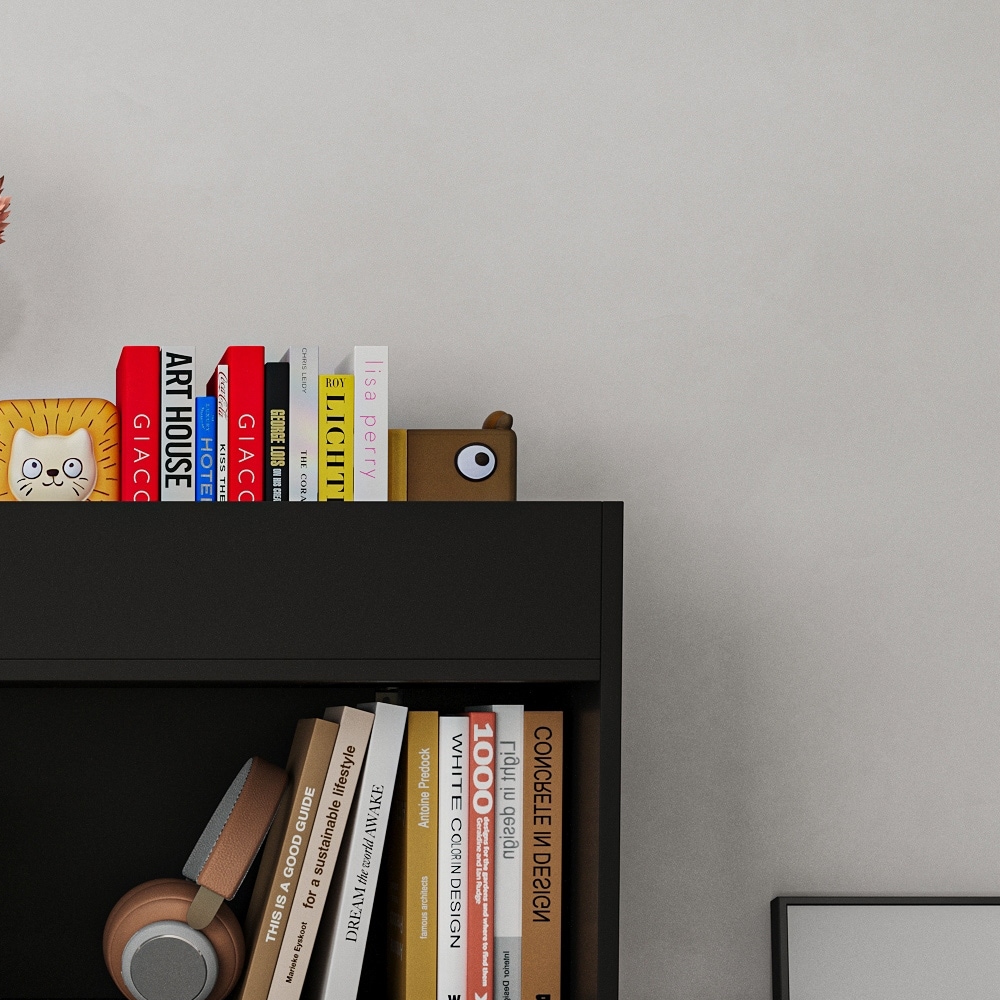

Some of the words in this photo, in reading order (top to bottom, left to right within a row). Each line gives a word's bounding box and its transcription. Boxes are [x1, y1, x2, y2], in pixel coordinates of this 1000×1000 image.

[165, 352, 193, 400] ART
[325, 378, 346, 388] ROY
[364, 361, 384, 401] lisa
[270, 409, 285, 443] GEORGE
[165, 407, 192, 488] HOUSE
[270, 446, 285, 467] LOIS
[359, 415, 377, 479] perry
[332, 745, 356, 797] lifestyle
[418, 747, 431, 789] Predock
[451, 733, 463, 811] WHITE
[472, 723, 494, 815] 1000
[295, 786, 316, 832] GUIDE
[365, 784, 385, 839] AWAKE
[418, 791, 430, 828] Antoine
[314, 799, 341, 875] sustainable
[450, 818, 462, 860] COLOR
[482, 816, 490, 845] designs
[283, 834, 302, 879] GOOD
[362, 838, 374, 868] world
[450, 862, 461, 874] IN
[280, 882, 291, 892] A
[310, 879, 320, 887] a
[357, 869, 369, 886] the
[420, 876, 428, 911] architects
[482, 871, 490, 902] gardens
[275, 894, 287, 909] IS
[302, 890, 317, 909] for
[345, 886, 366, 943] DREAM
[449, 879, 461, 948] DESIGN
[265, 910, 283, 943] THIS
[420, 912, 428, 939] famous
[286, 952, 299, 984] Marieke
[294, 921, 308, 952] Eyskoot
[482, 942, 489, 950] to
